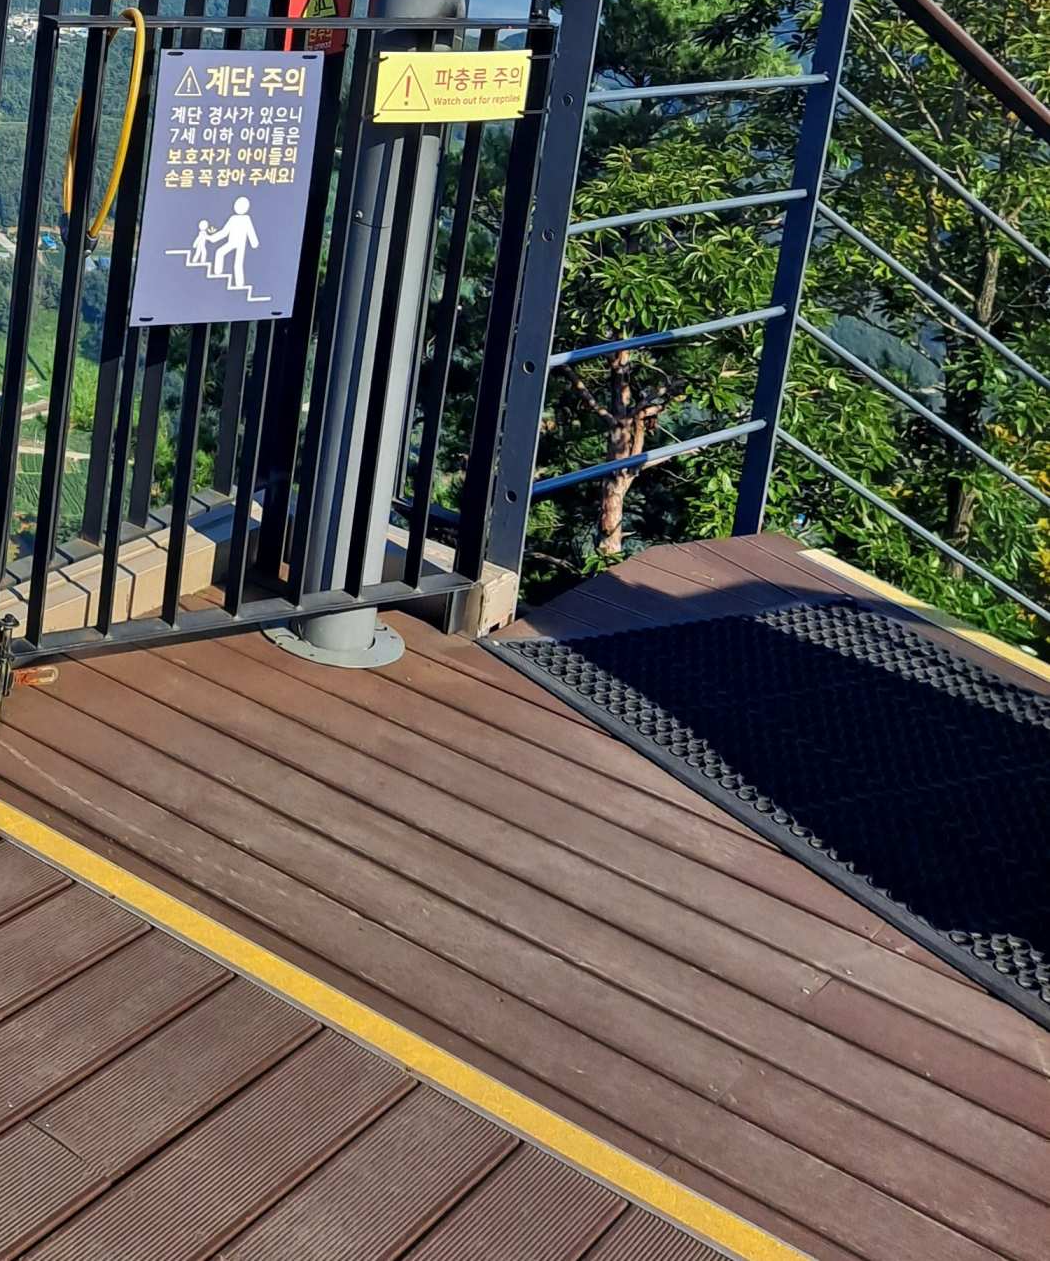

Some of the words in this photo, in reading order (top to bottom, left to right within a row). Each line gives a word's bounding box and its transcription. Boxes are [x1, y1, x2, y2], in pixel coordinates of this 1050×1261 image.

[205, 65, 255, 97] 계단
[260, 66, 306, 97] 주의
[435, 67, 487, 91] 파충류
[493, 65, 524, 89] 주의
[434, 96, 461, 106] Watch
[463, 97, 477, 105] out
[479, 95, 490, 105] for
[492, 94, 520, 105] reptiles
[170, 106, 203, 125] 계단
[208, 106, 255, 125] 경사가
[260, 106, 303, 125] 있으니
[169, 127, 196, 144] 7세
[203, 127, 234, 145] 이하
[240, 126, 300, 146] 아이들은
[166, 148, 231, 165] 보호자가
[237, 147, 298, 166] 아이들의
[164, 169, 194, 188] 손을
[198, 169, 213, 187] 꼭
[217, 168, 246, 187] 잡아
[249, 167, 295, 186] 주세요!
